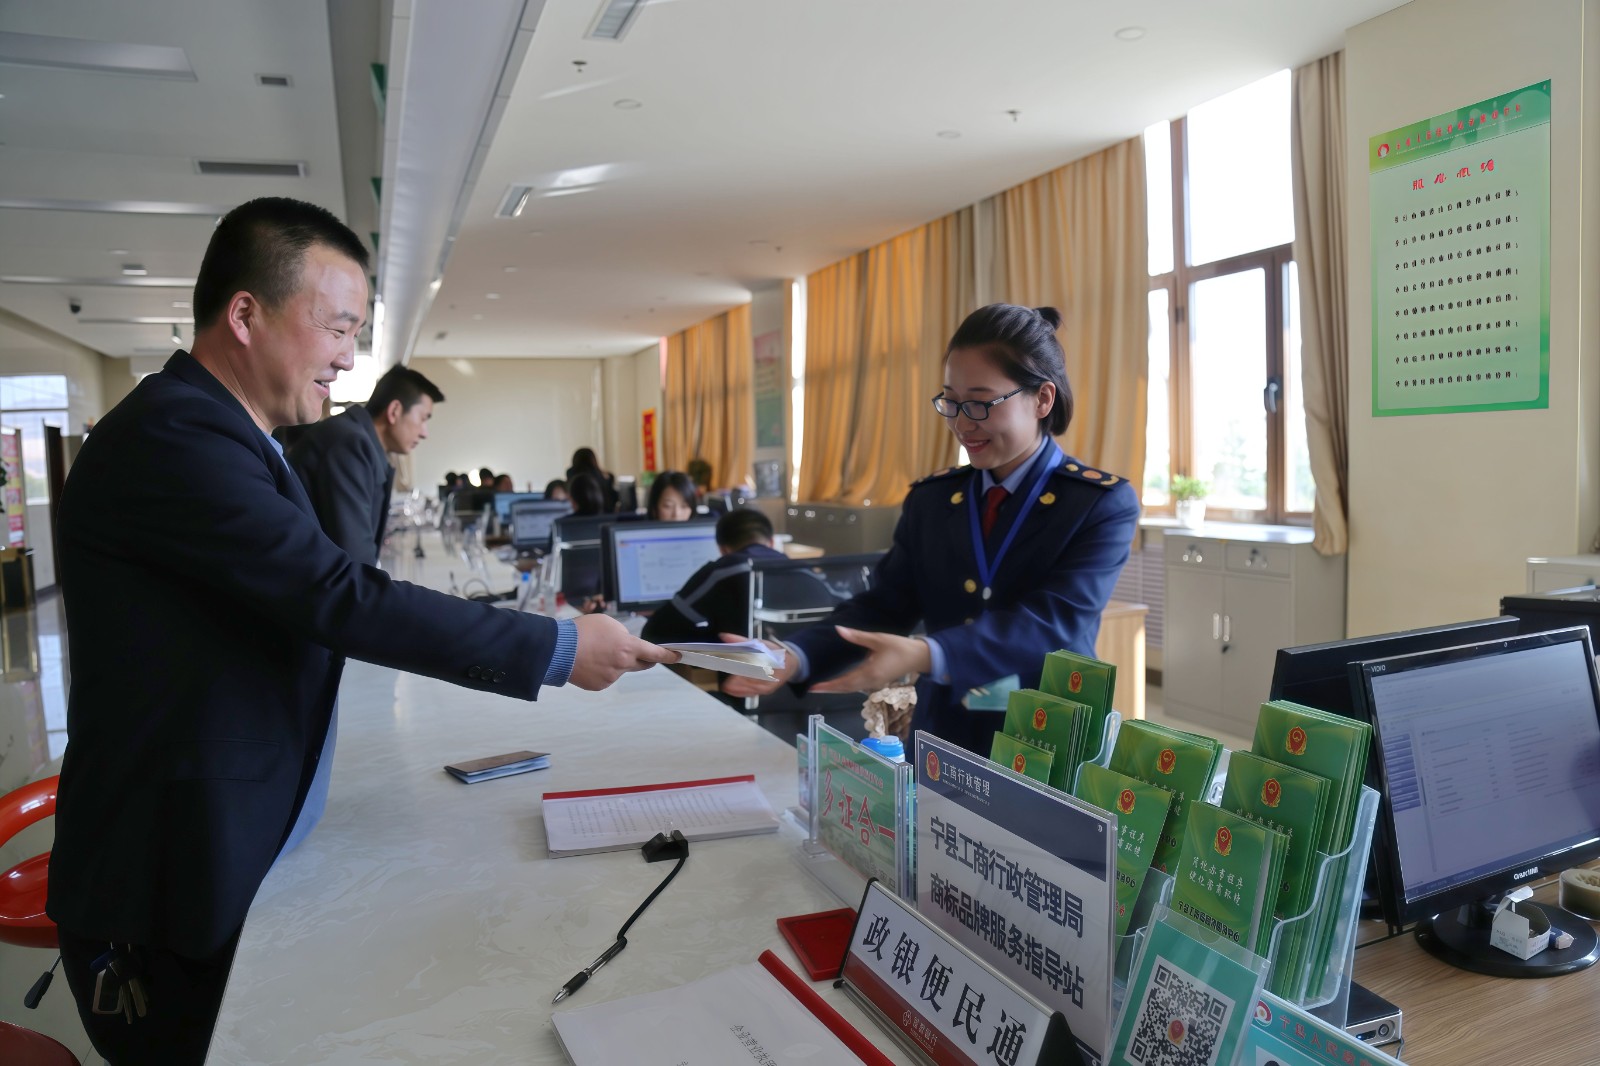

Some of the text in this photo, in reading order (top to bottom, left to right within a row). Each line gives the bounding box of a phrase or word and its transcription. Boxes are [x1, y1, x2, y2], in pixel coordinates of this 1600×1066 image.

[822, 768, 895, 846] 多证合一
[942, 761, 990, 797] 工商行政管理
[930, 816, 1083, 938] 宁县工商行政管理局
[862, 913, 1027, 1066] 政银便民通
[930, 872, 1084, 1009] 商标品牌服务指导站
